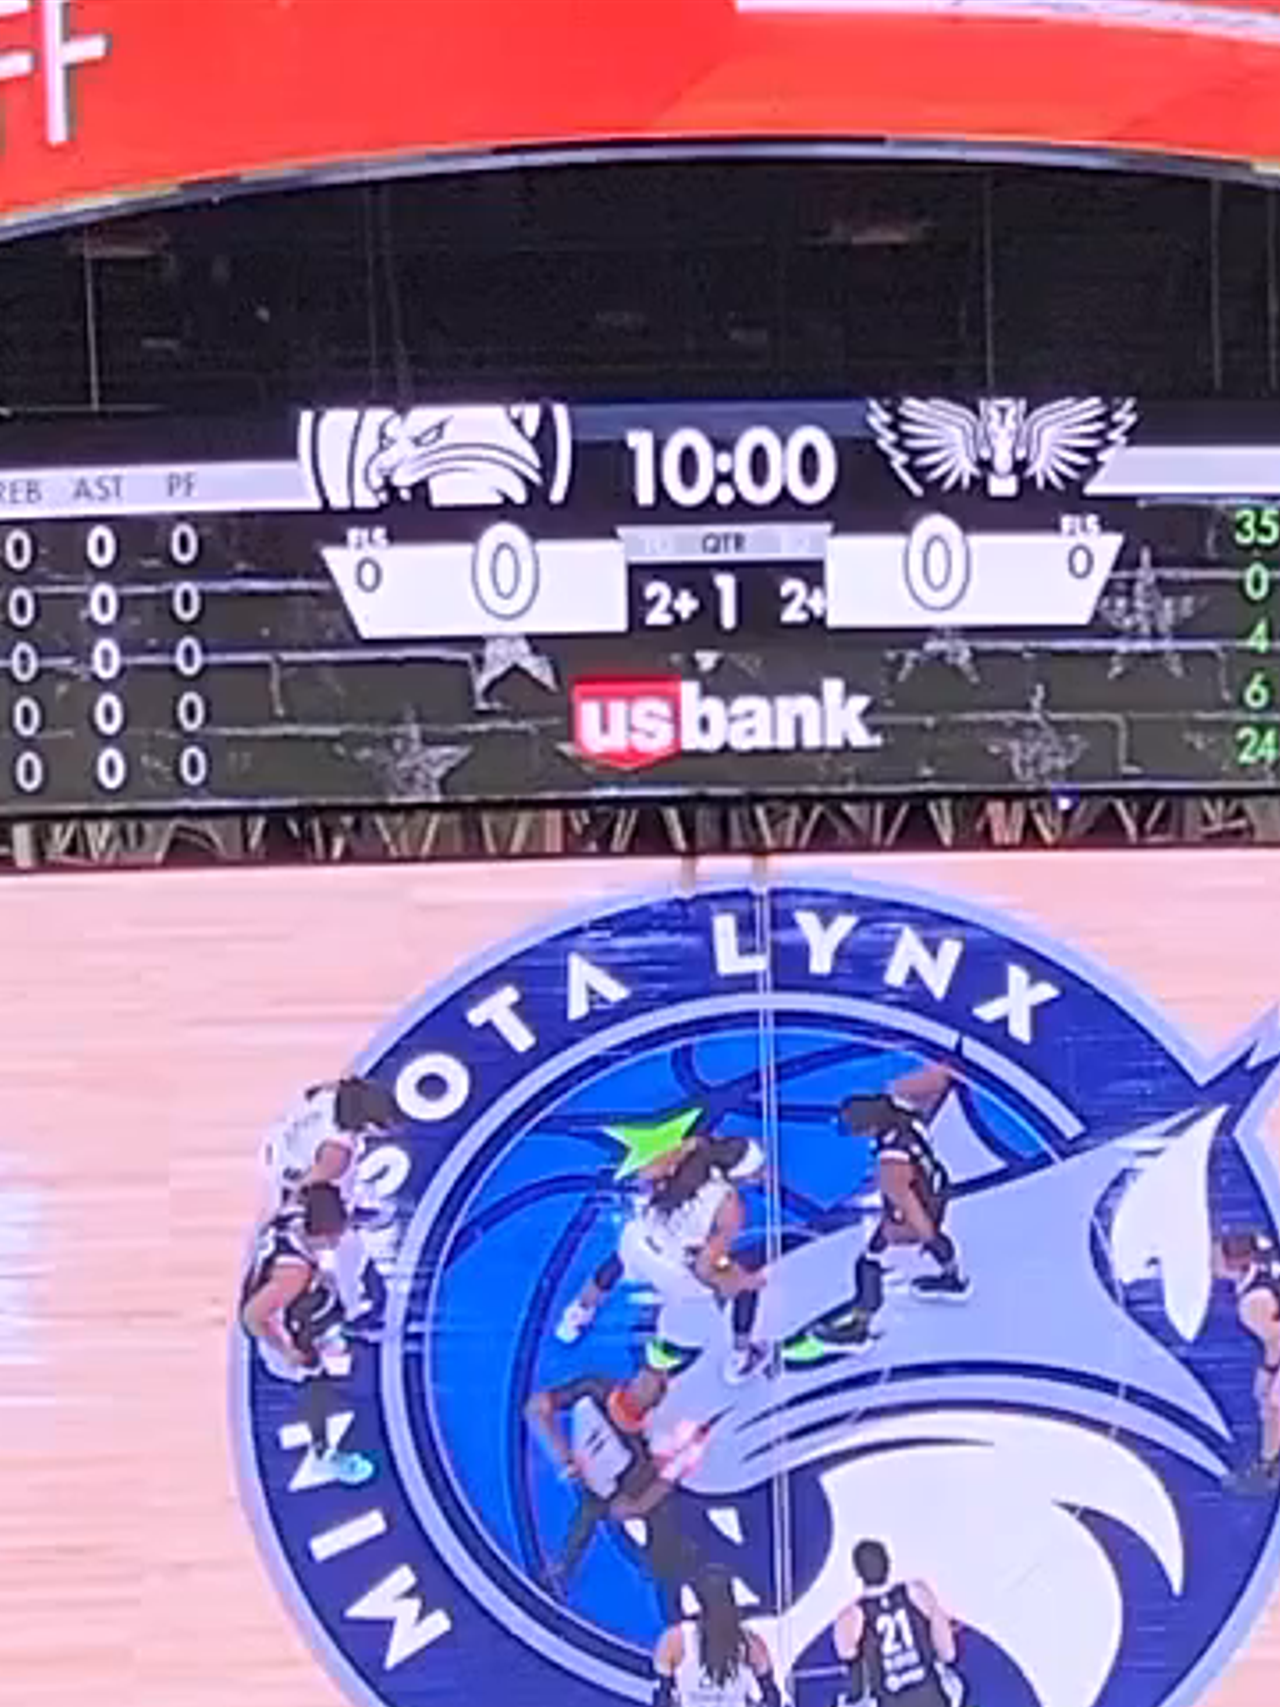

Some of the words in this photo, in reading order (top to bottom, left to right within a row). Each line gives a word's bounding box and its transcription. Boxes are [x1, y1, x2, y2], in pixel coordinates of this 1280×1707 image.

[73, 476, 123, 501] AST
[168, 473, 198, 497] PF
[626, 428, 837, 506] 10:00
[5, 530, 31, 569] 0
[87, 526, 115, 567] 0
[172, 524, 198, 563] 0
[1235, 511, 1279, 545] 35
[357, 558, 381, 592] 0
[472, 523, 539, 619] 0
[905, 514, 972, 610] 0
[1068, 547, 1093, 578] 0
[1245, 565, 1269, 599] 0
[8, 588, 34, 627] 0
[90, 583, 117, 624] 0
[173, 581, 201, 620] 0
[645, 582, 698, 624] 2+
[716, 574, 736, 629] 1
[1248, 620, 1269, 653] 4
[11, 643, 38, 681] 0
[92, 638, 120, 679] 0
[176, 637, 203, 675] 0
[1245, 675, 1268, 708] 6
[15, 698, 41, 737] 0
[95, 694, 123, 734] 0
[178, 692, 204, 731] 0
[578, 678, 876, 752] usbank
[16, 752, 42, 790] 0
[97, 748, 125, 789] 0
[180, 745, 206, 784] 0
[1238, 729, 1278, 765] 24
[710, 908, 1061, 1044] LYNX
[877, 1608, 917, 1648] 21
